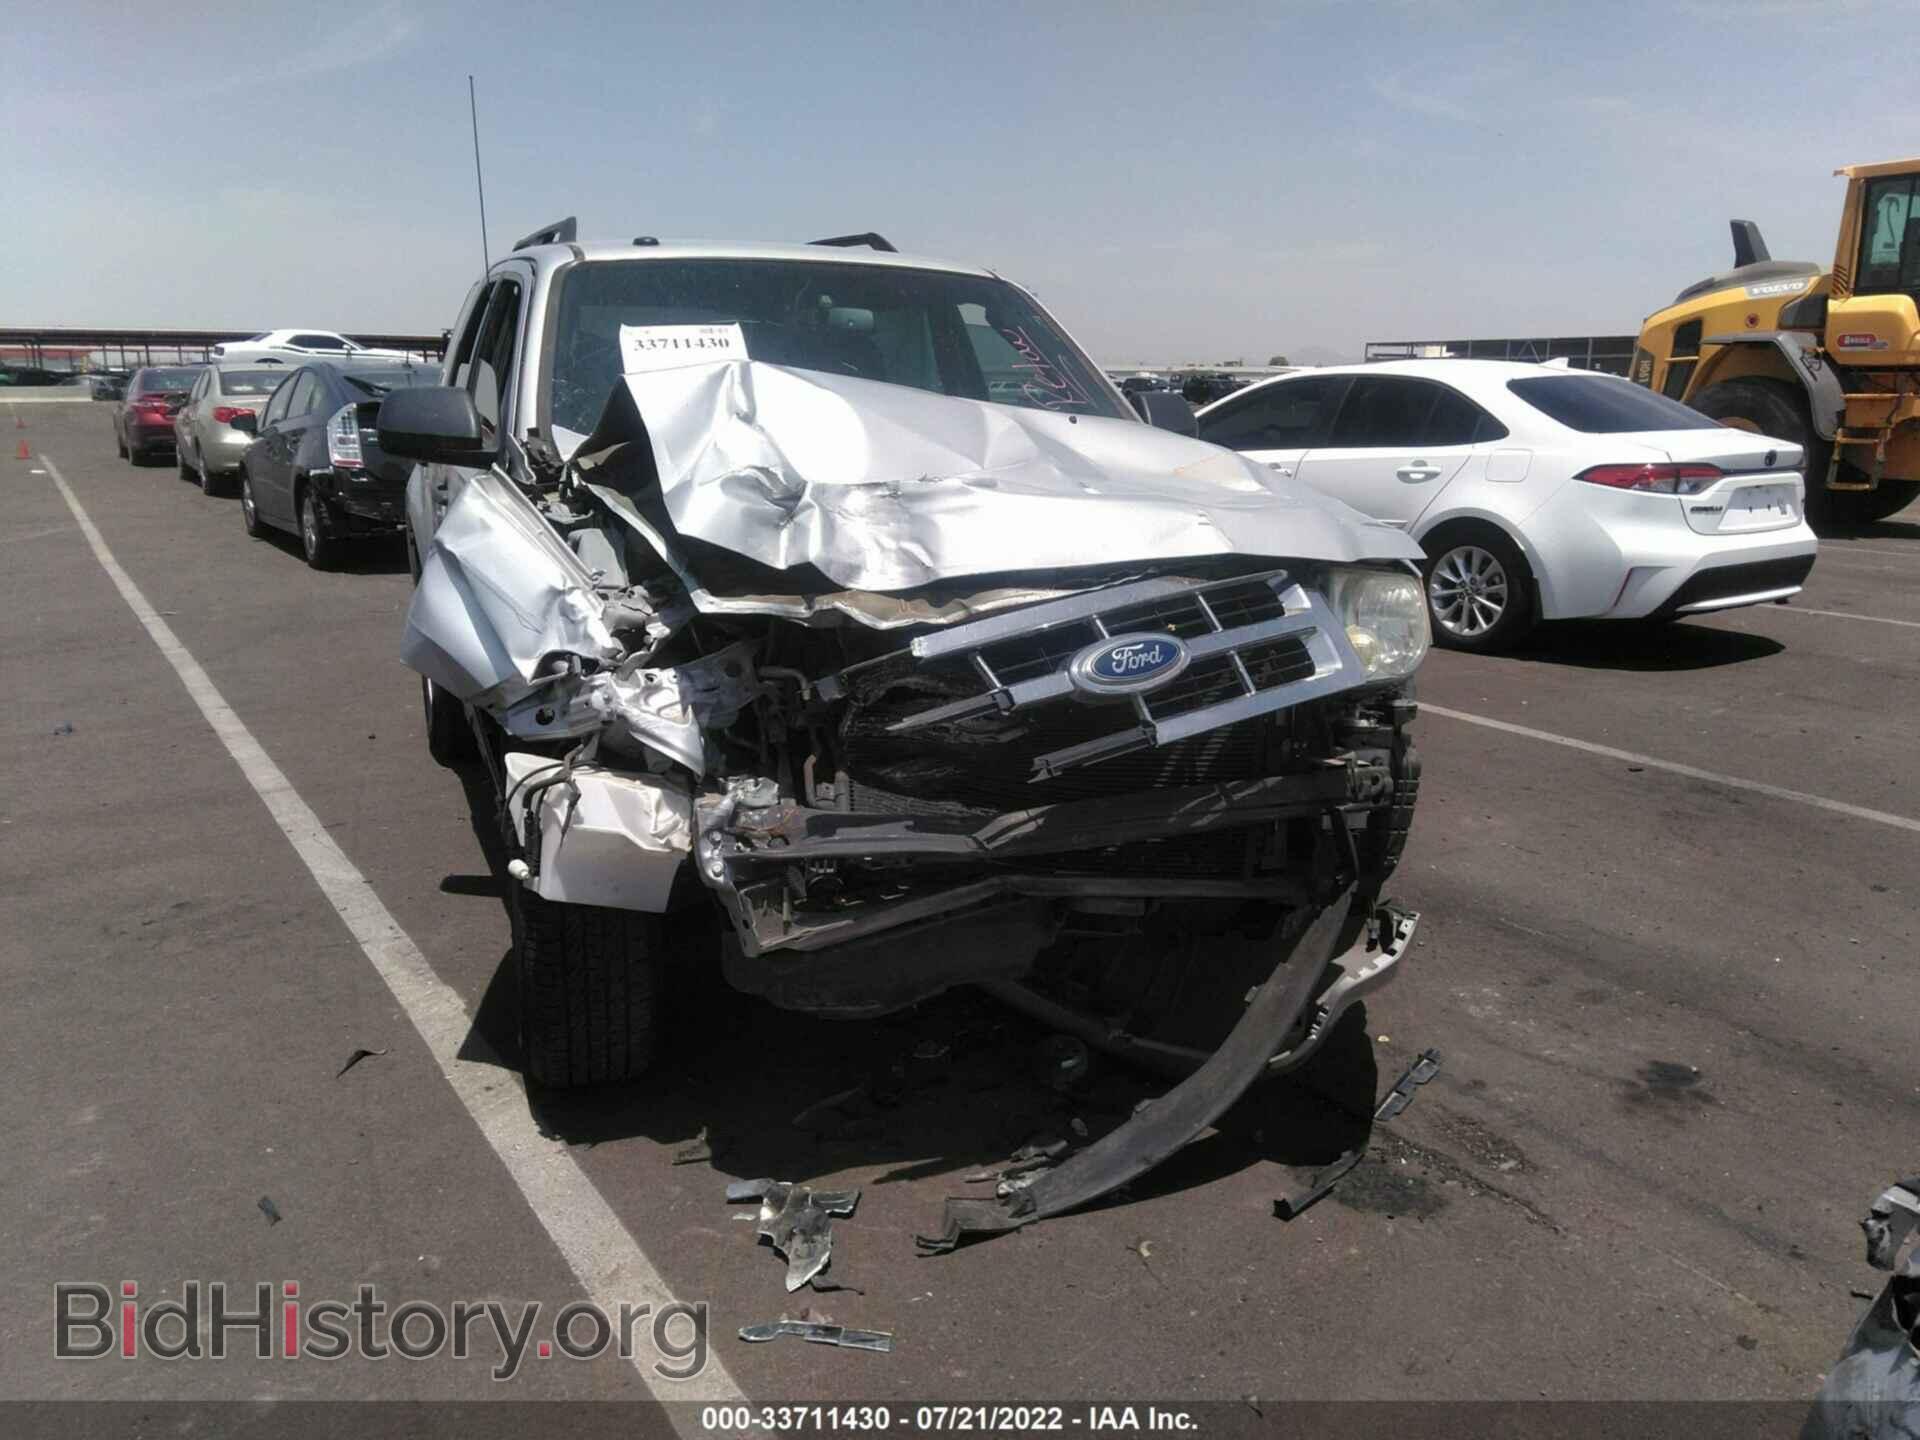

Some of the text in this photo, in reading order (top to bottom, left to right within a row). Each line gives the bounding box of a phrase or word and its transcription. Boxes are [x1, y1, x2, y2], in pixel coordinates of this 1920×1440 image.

[1751, 282, 1804, 295] VOLVO
[633, 337, 730, 351] 33711430
[1111, 643, 1163, 673] Ford
